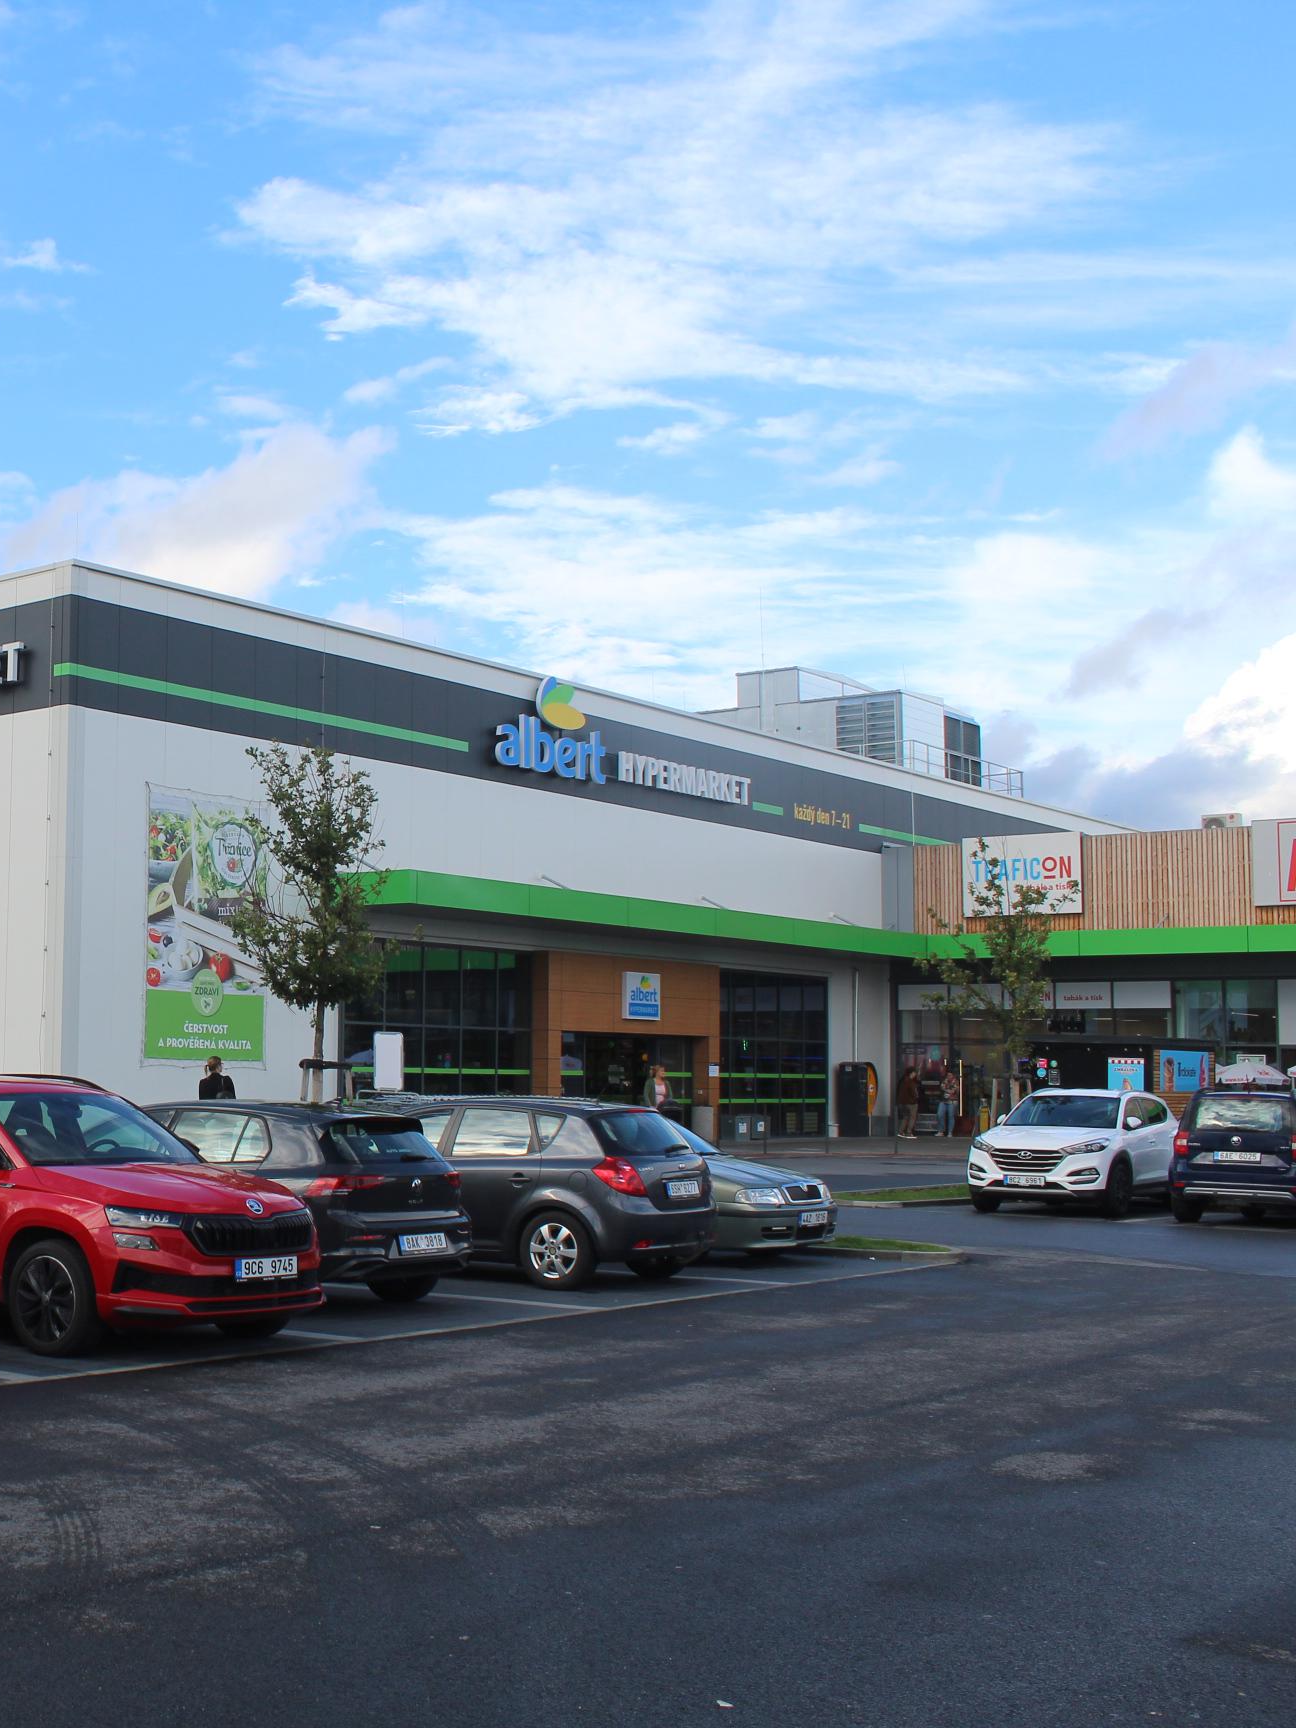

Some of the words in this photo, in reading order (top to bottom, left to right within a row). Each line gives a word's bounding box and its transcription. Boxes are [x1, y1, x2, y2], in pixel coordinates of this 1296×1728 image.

[495, 714, 606, 784] albert
[617, 750, 751, 806] HYPERMARKET
[793, 803, 815, 825] každý
[816, 807, 830, 824] den
[972, 856, 1072, 882] TRAFICON
[218, 903, 235, 916] mix
[631, 987, 657, 1002] albert
[183, 1020, 228, 1034] ČERSTVOST
[158, 1038, 164, 1048] A
[166, 1036, 216, 1049] PROVĚŘENÁ
[218, 1039, 251, 1050] KVALITA
[406, 1236, 421, 1250] 8AK
[244, 1260, 263, 1275] 9C6
[271, 1259, 293, 1274] 9745
